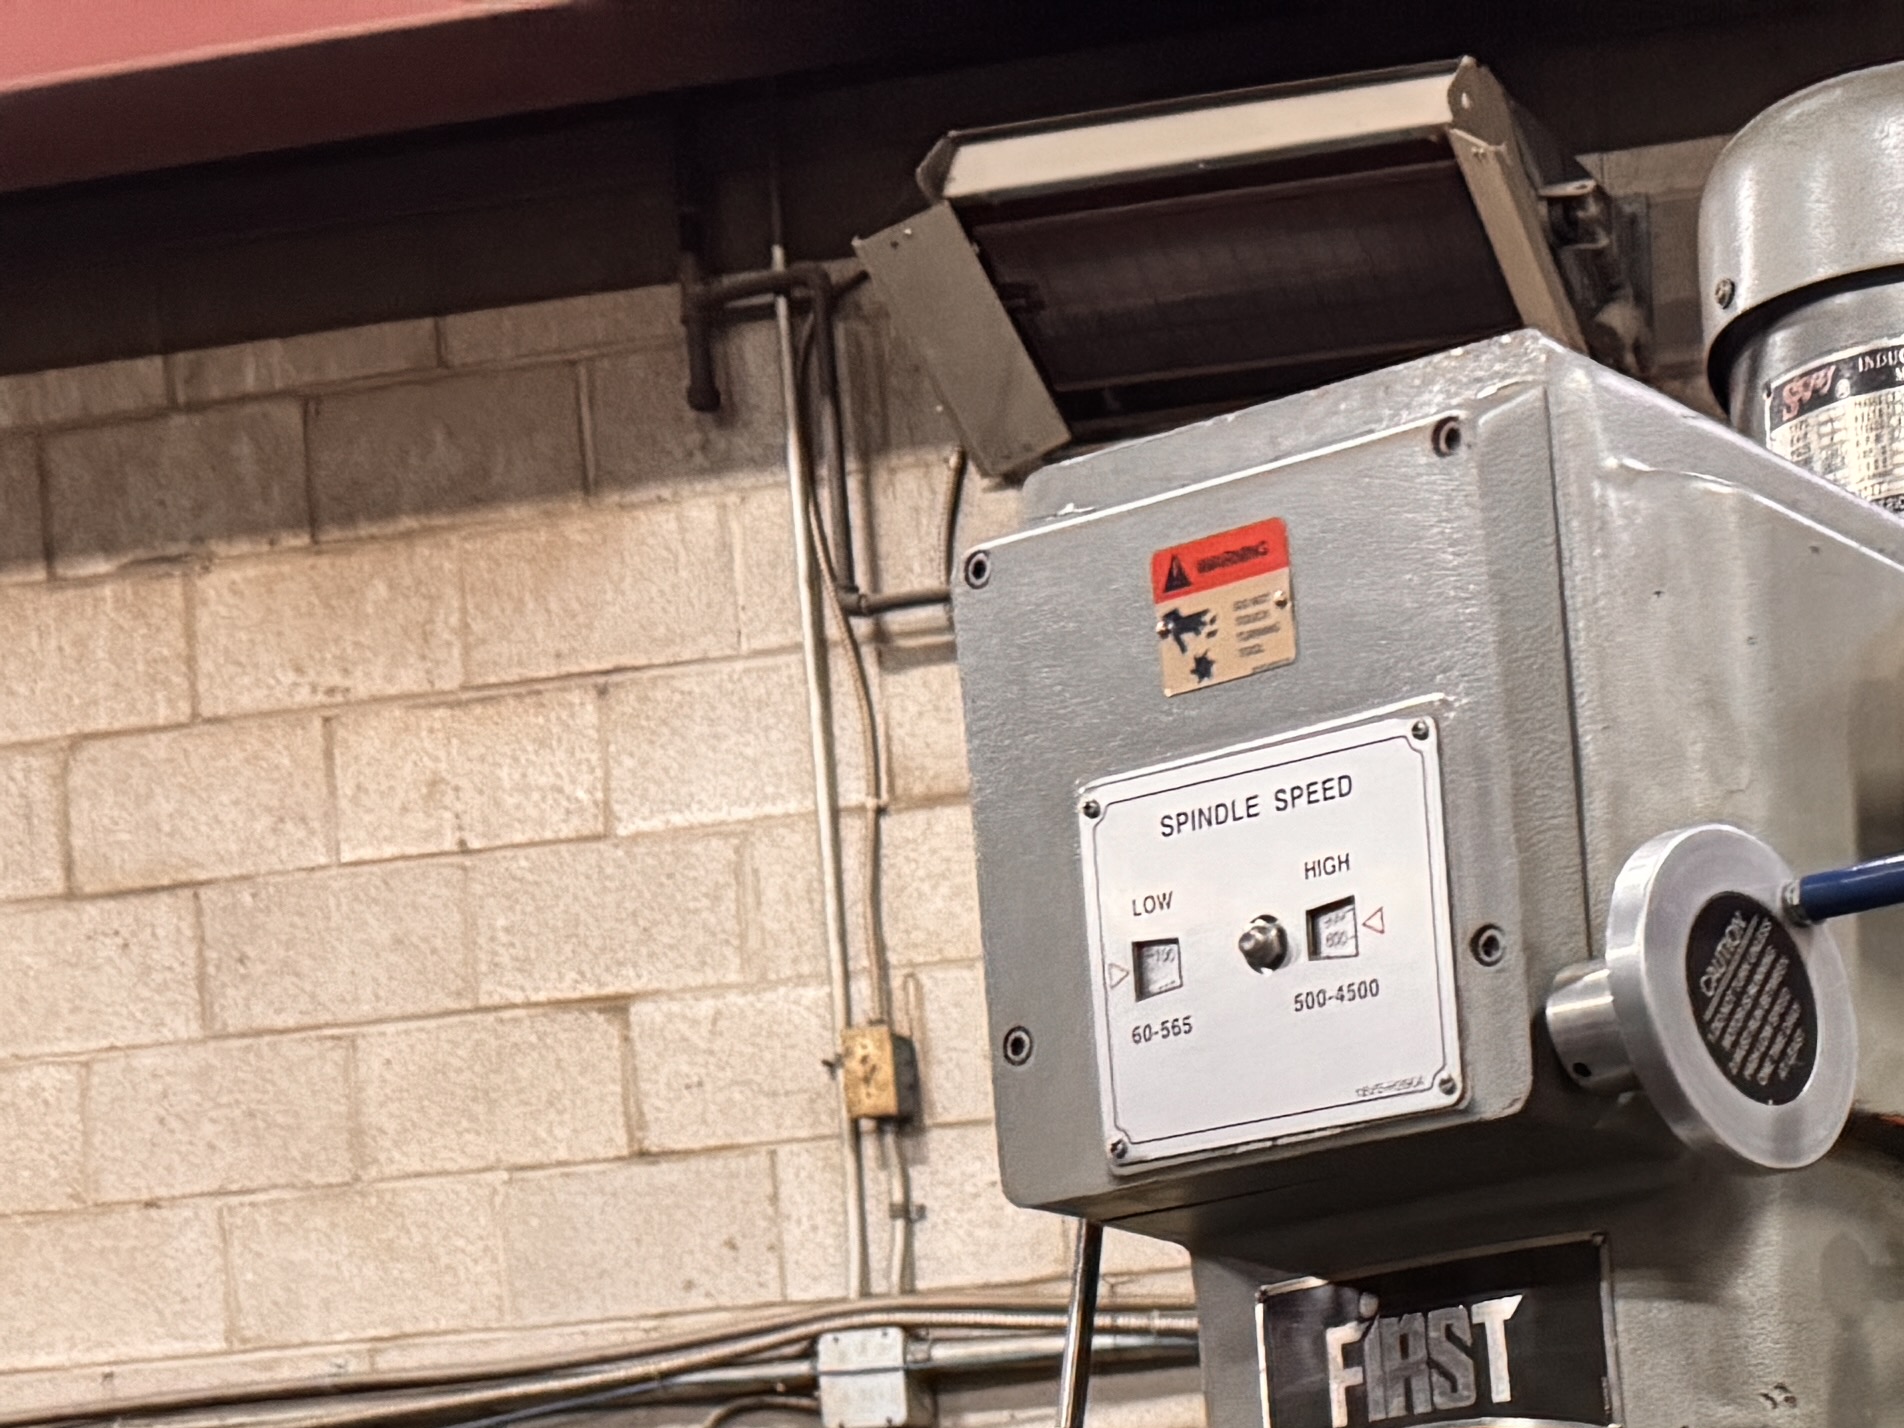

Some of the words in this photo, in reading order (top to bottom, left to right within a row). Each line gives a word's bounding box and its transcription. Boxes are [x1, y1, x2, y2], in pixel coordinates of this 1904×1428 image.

[1160, 794, 1260, 838] SPINDLE
[1274, 774, 1353, 812] SPEED
[1304, 853, 1351, 880] HIGH
[1132, 891, 1174, 917] LOW
[1294, 978, 1380, 1013] 500-4500
[1131, 1015, 1193, 1045] 60-565
[1326, 1291, 1524, 1428] FIRST
